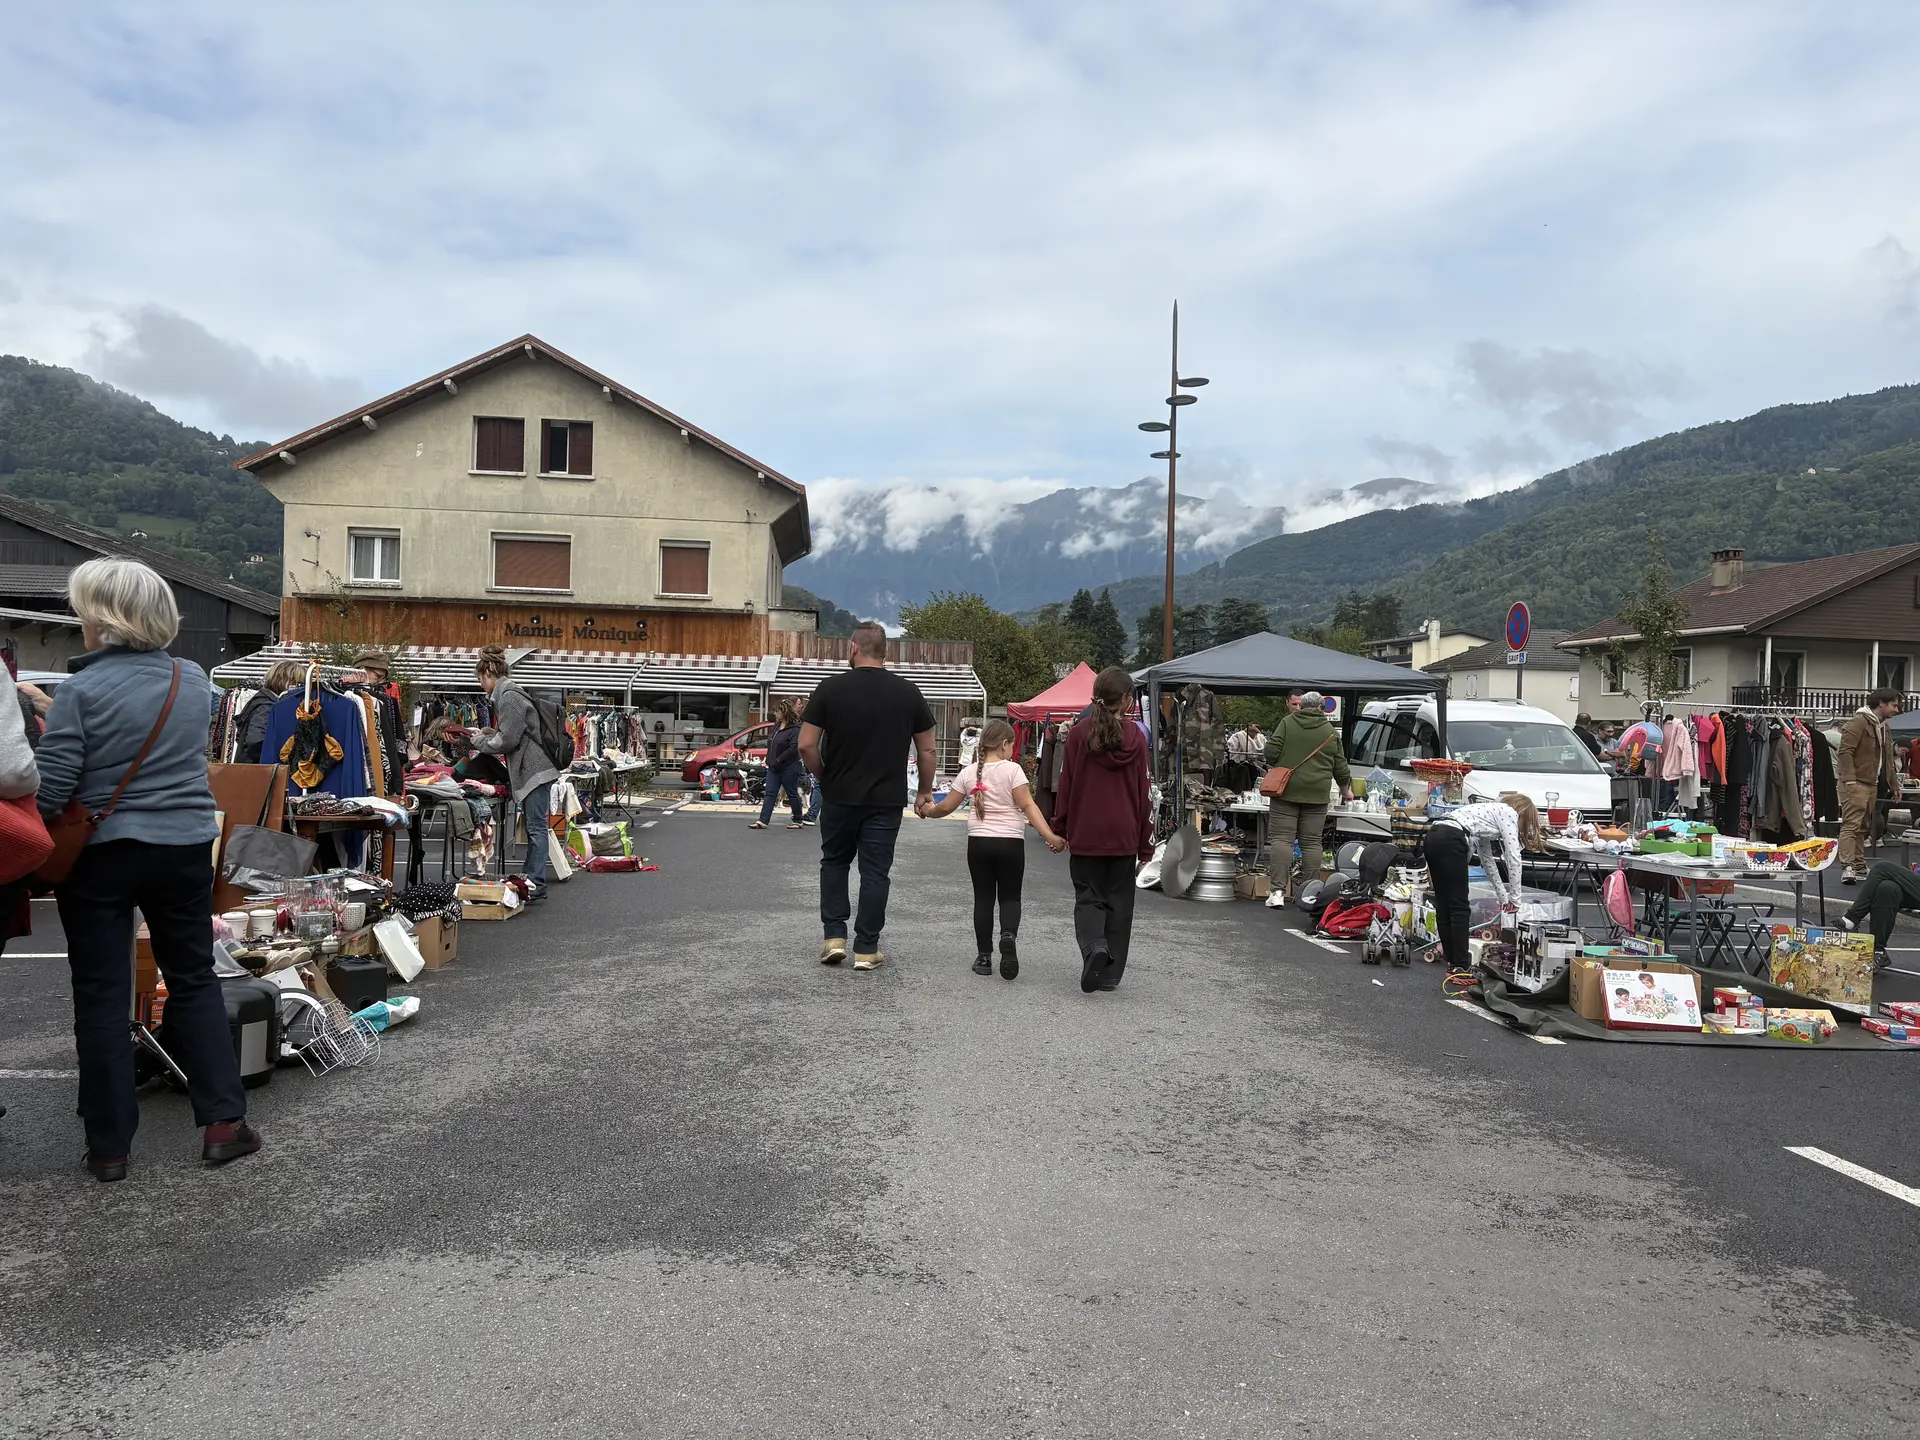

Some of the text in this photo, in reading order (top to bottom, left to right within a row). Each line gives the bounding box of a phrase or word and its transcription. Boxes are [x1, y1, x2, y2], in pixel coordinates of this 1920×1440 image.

[504, 622, 648, 644] Mamie Monique
[1508, 654, 1519, 663] SAUF
